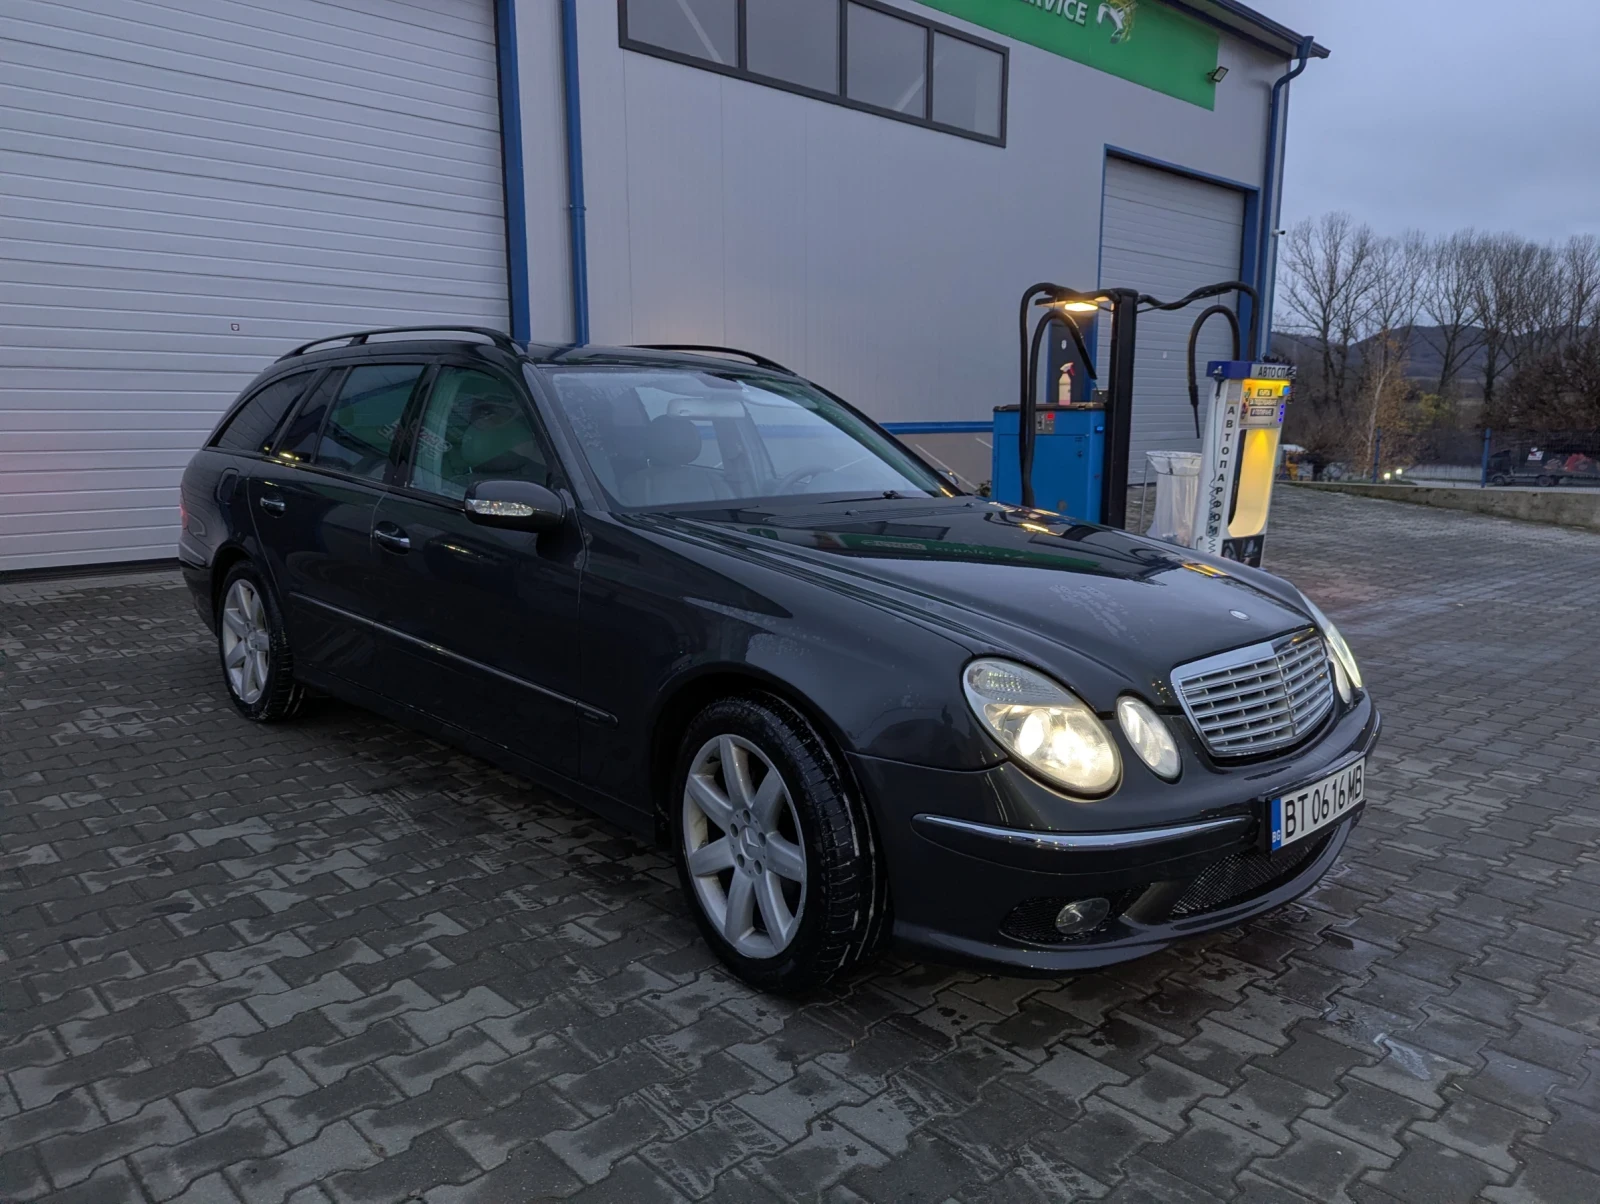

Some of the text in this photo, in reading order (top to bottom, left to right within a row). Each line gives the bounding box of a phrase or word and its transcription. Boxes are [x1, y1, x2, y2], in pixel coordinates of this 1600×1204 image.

[1258, 366, 1276, 378] АВТО
[1285, 764, 1362, 839] BT 0616 MB
[1271, 829, 1281, 843] BG
